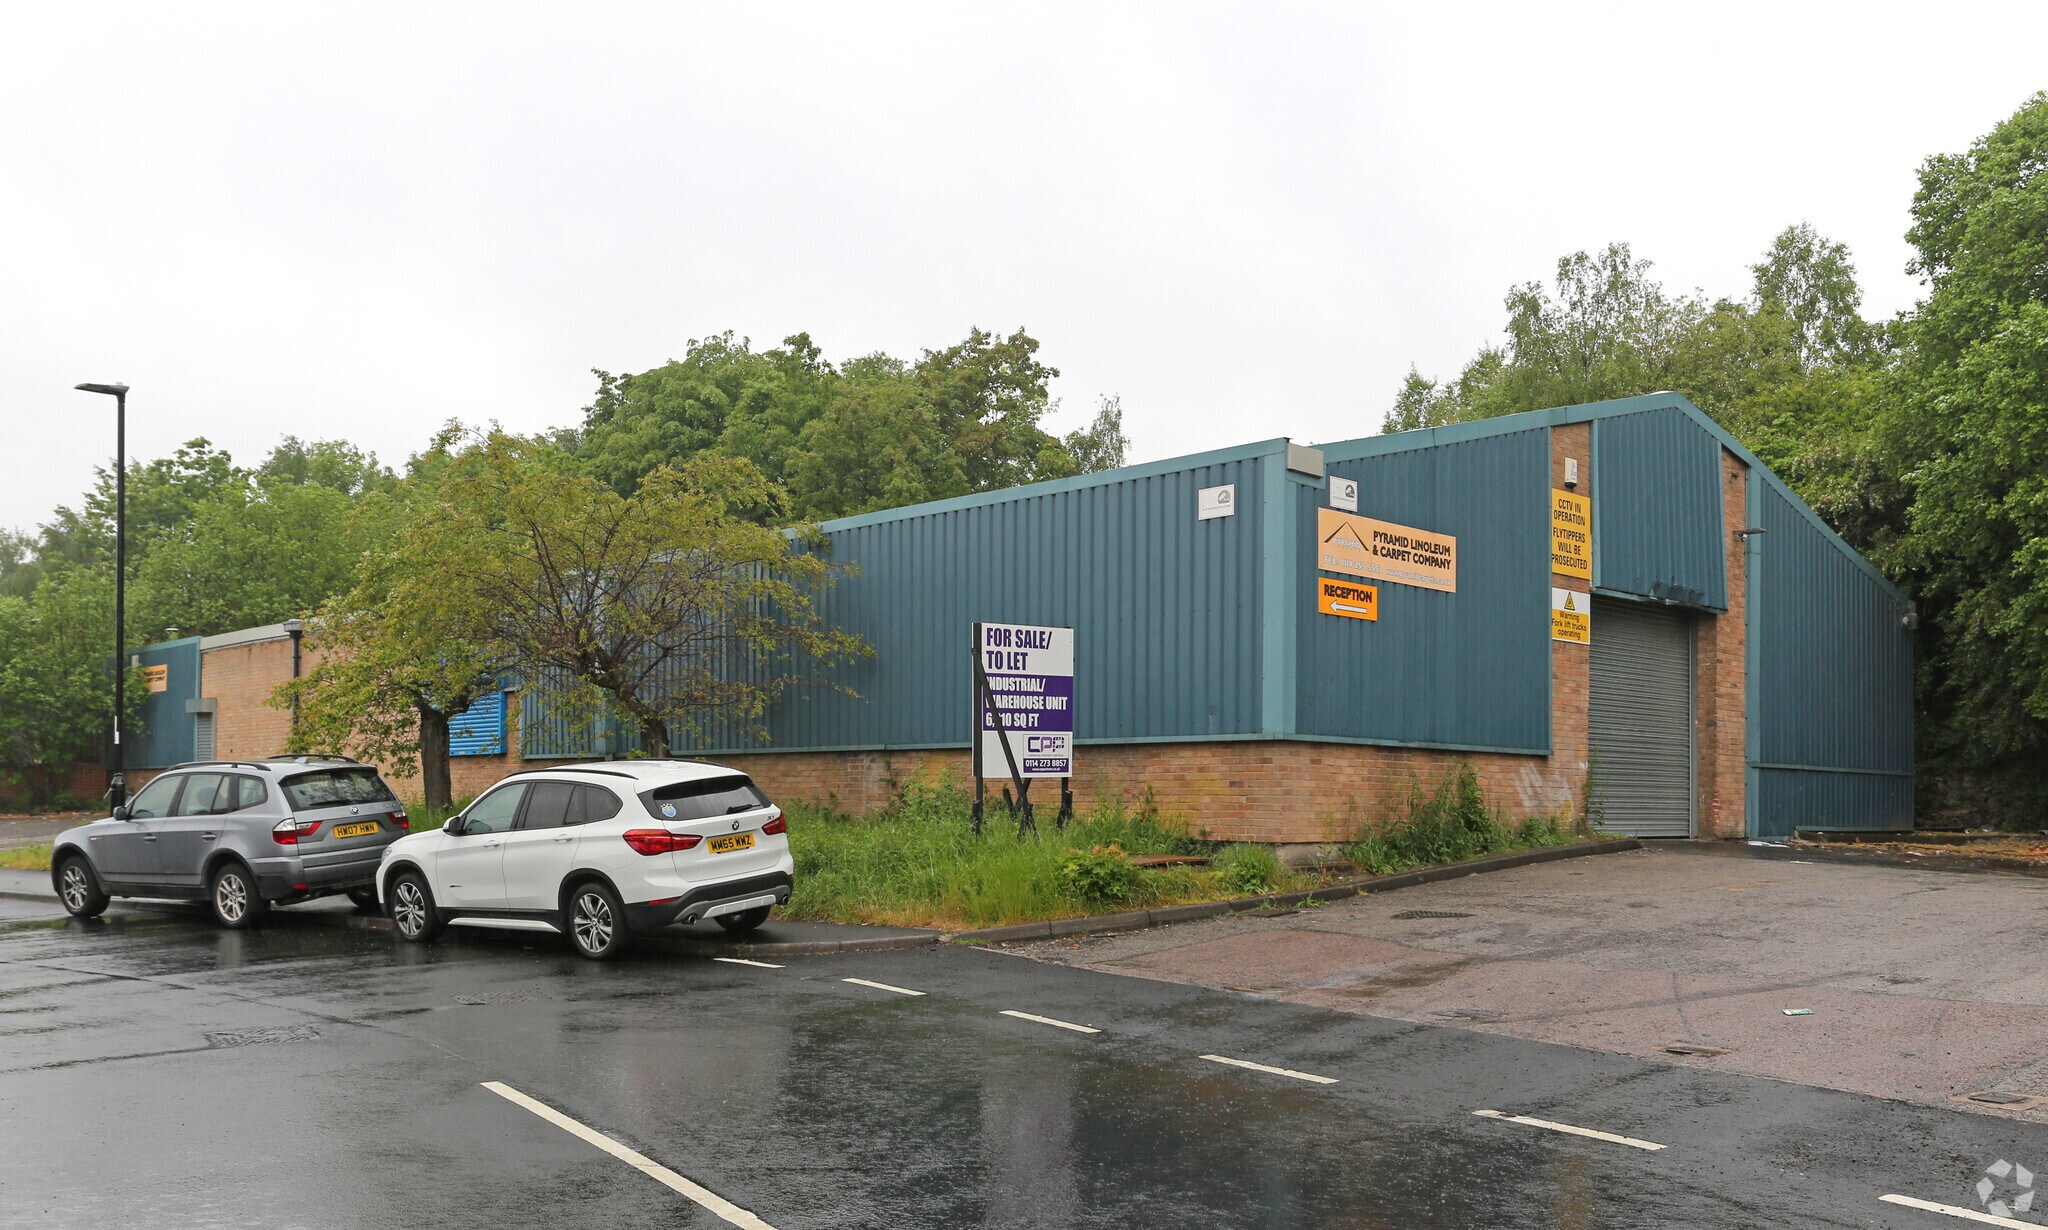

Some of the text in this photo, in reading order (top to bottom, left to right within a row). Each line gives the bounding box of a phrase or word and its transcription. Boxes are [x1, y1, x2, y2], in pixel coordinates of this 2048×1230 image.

[1558, 498, 1582, 514] CCTV IN
[1553, 509, 1586, 526] OPERATION
[1552, 526, 1586, 543] FLYTIPPERS
[1373, 530, 1451, 557] PYRAMID LINOLEUM
[1557, 541, 1581, 556] WILL BE
[1372, 544, 1452, 570] & CARPET COMPANY
[1551, 553, 1588, 570] PROSECUTED
[1323, 583, 1373, 603] RECEPTION
[1551, 617, 1563, 627] Fork
[1572, 622, 1587, 632] trucks
[1559, 610, 1580, 623] Warning
[986, 627, 1052, 650] FOR SALE/
[1557, 628, 1581, 641] operating
[986, 650, 1028, 671] TO LET
[1046, 696, 1068, 710] UNIT
[985, 712, 1040, 728] 6,10 SQ FT
[1025, 759, 1067, 767] 0114 273 8857
[337, 825, 358, 836] HW07
[711, 838, 734, 851] MM65
